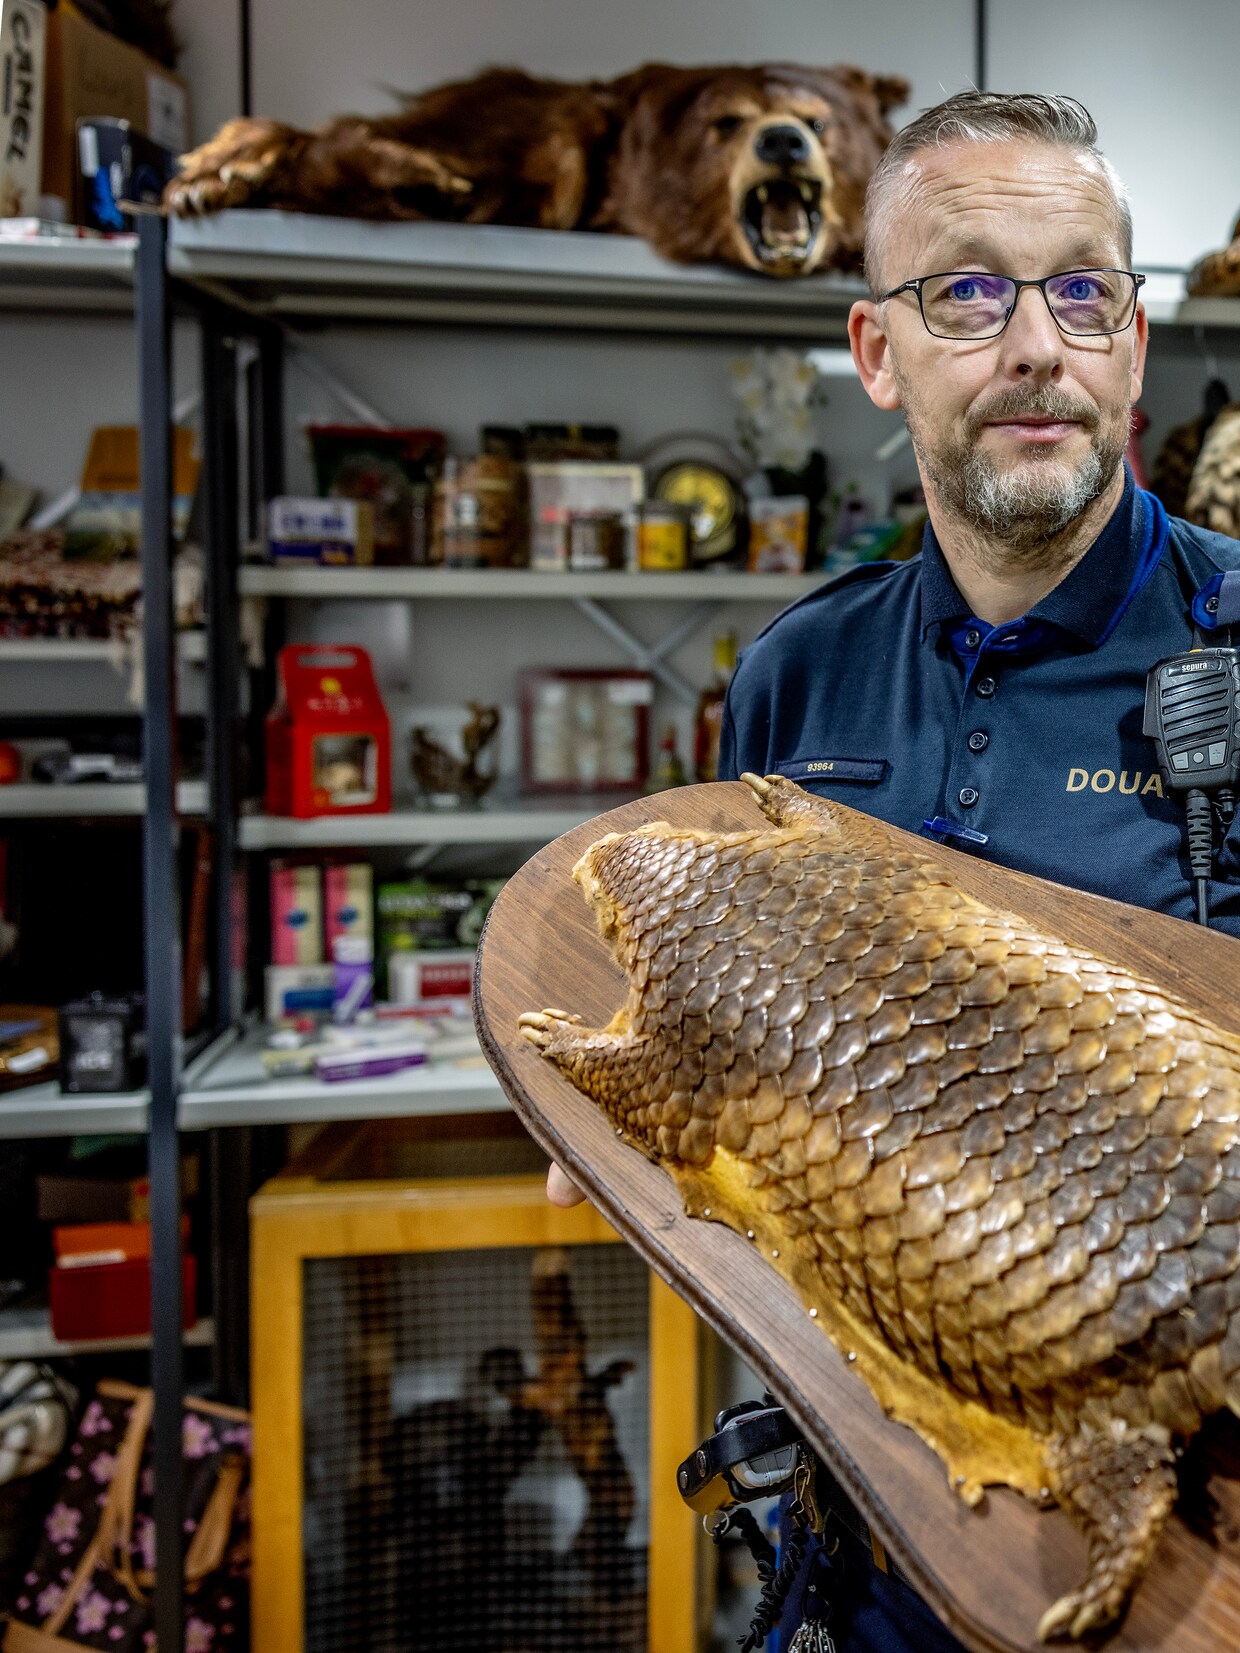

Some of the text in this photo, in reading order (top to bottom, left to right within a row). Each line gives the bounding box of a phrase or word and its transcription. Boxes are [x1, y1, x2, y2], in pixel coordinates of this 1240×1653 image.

[7, 11, 32, 163] CAMEL
[1181, 662, 1208, 672] sepura
[807, 762, 834, 772] 93964
[1066, 768, 1169, 799] DOUA
